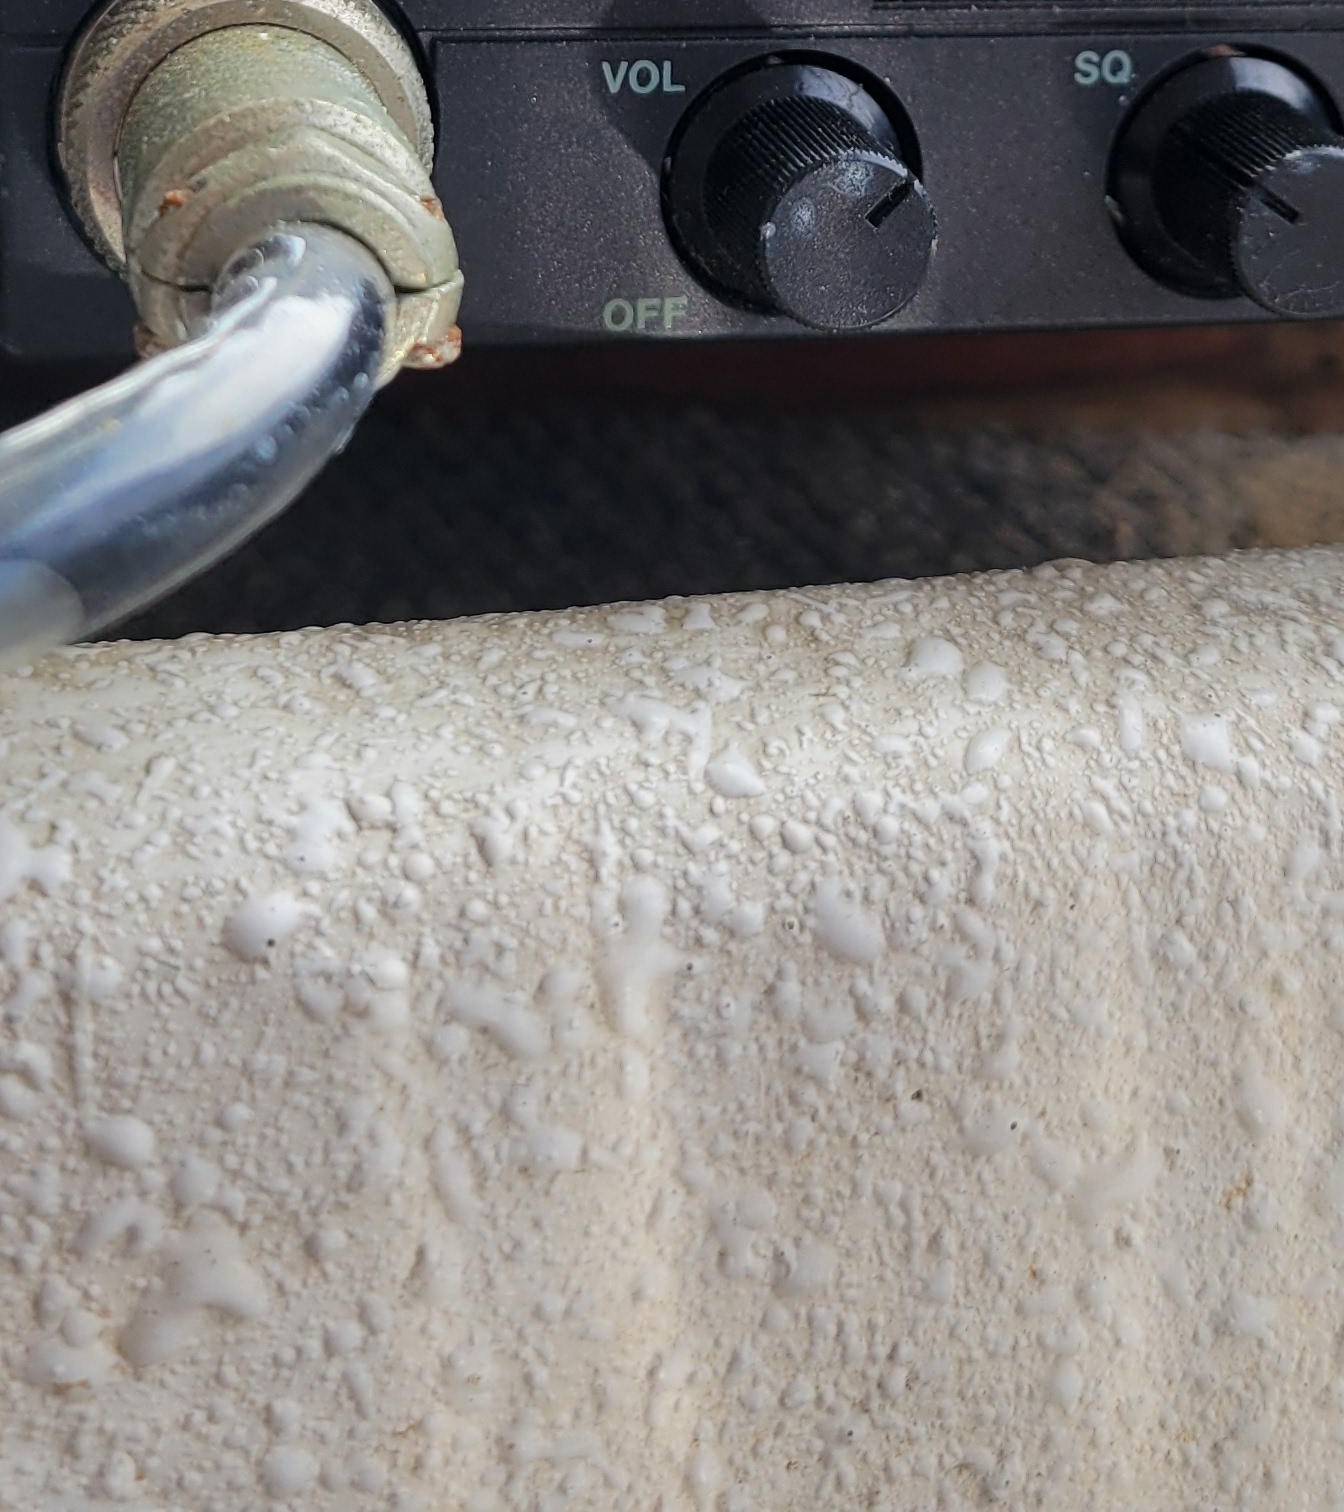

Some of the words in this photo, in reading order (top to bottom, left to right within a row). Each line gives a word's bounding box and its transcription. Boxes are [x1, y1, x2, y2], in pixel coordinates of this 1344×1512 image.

[601, 59, 686, 94] VOL
[1073, 49, 1132, 85] SQ
[603, 296, 688, 331] OFF
